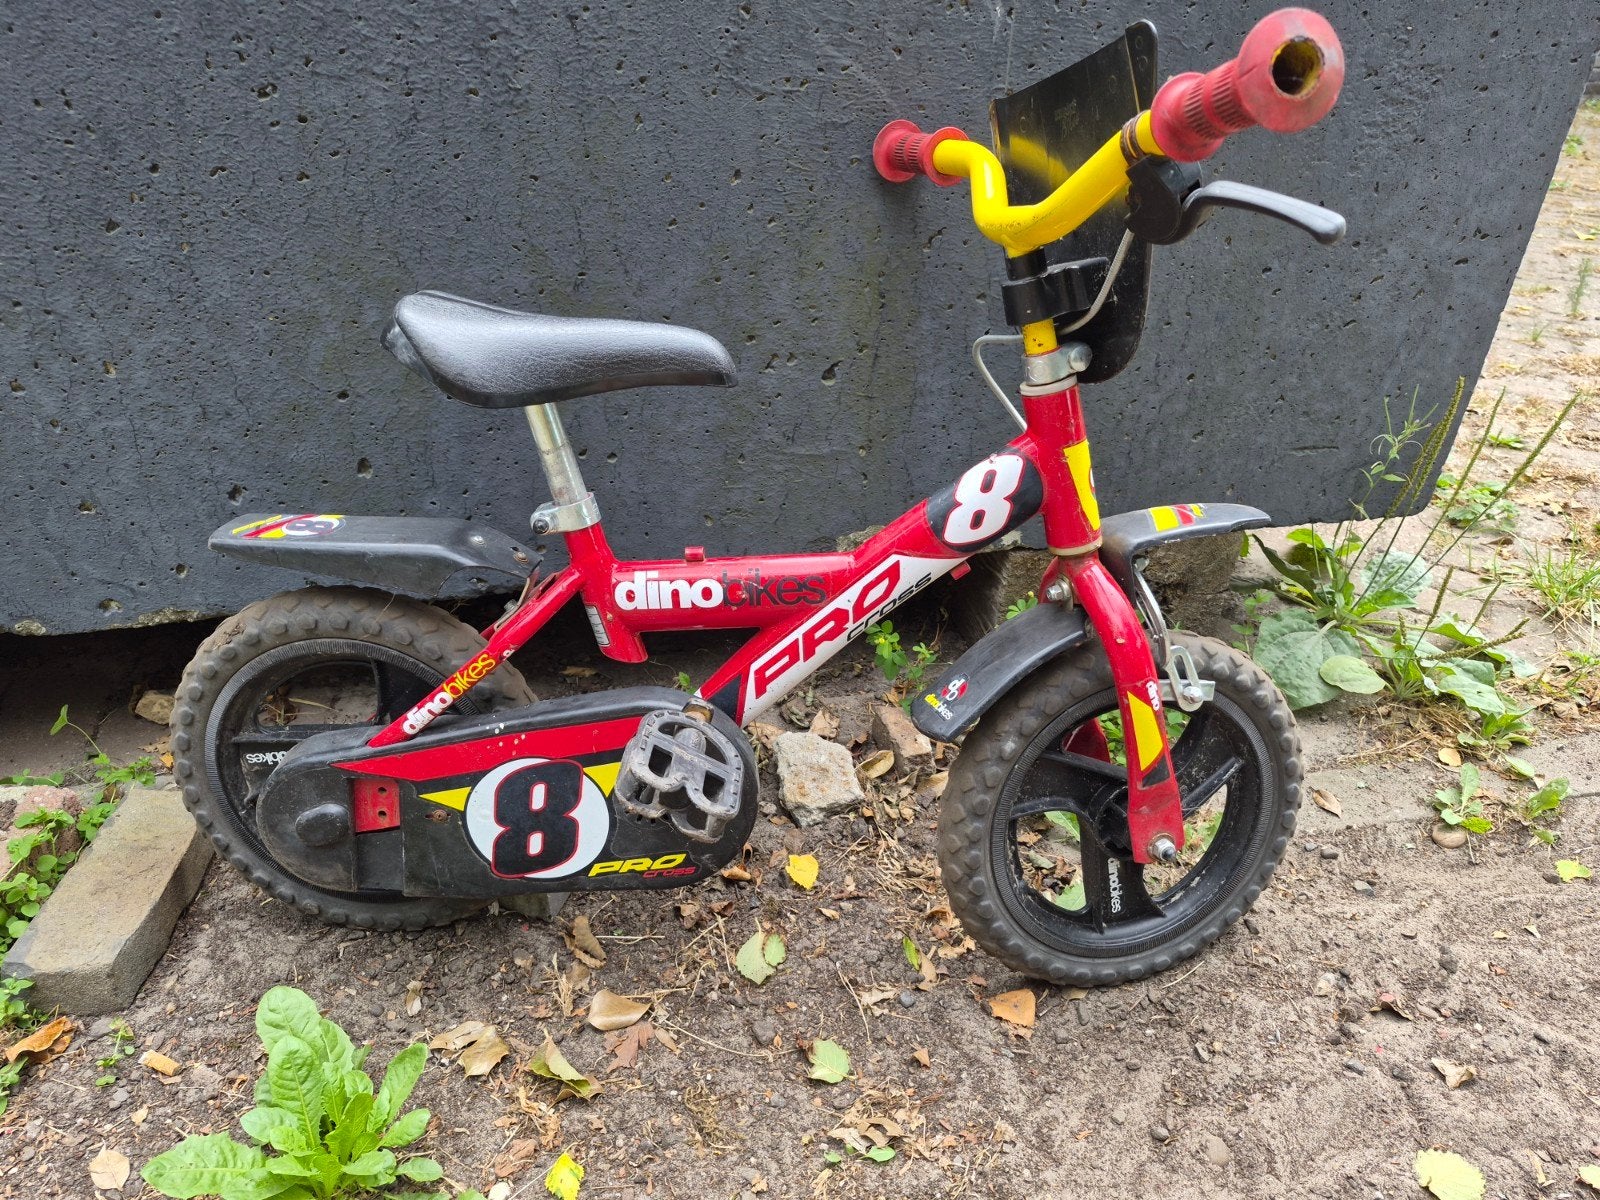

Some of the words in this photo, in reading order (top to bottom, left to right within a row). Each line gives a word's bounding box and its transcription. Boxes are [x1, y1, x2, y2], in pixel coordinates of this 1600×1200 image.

[942, 453, 1026, 547] 8
[614, 568, 827, 611] dinobikes
[846, 571, 932, 642] cross
[754, 560, 901, 700] PRO
[402, 653, 497, 735] dinobikes
[924, 693, 954, 720] dinobikes
[1145, 680, 1160, 711] dino
[491, 758, 585, 880] 8
[587, 853, 687, 877] PRO
[642, 866, 697, 878] cross
[1107, 857, 1122, 913] dinobikes
